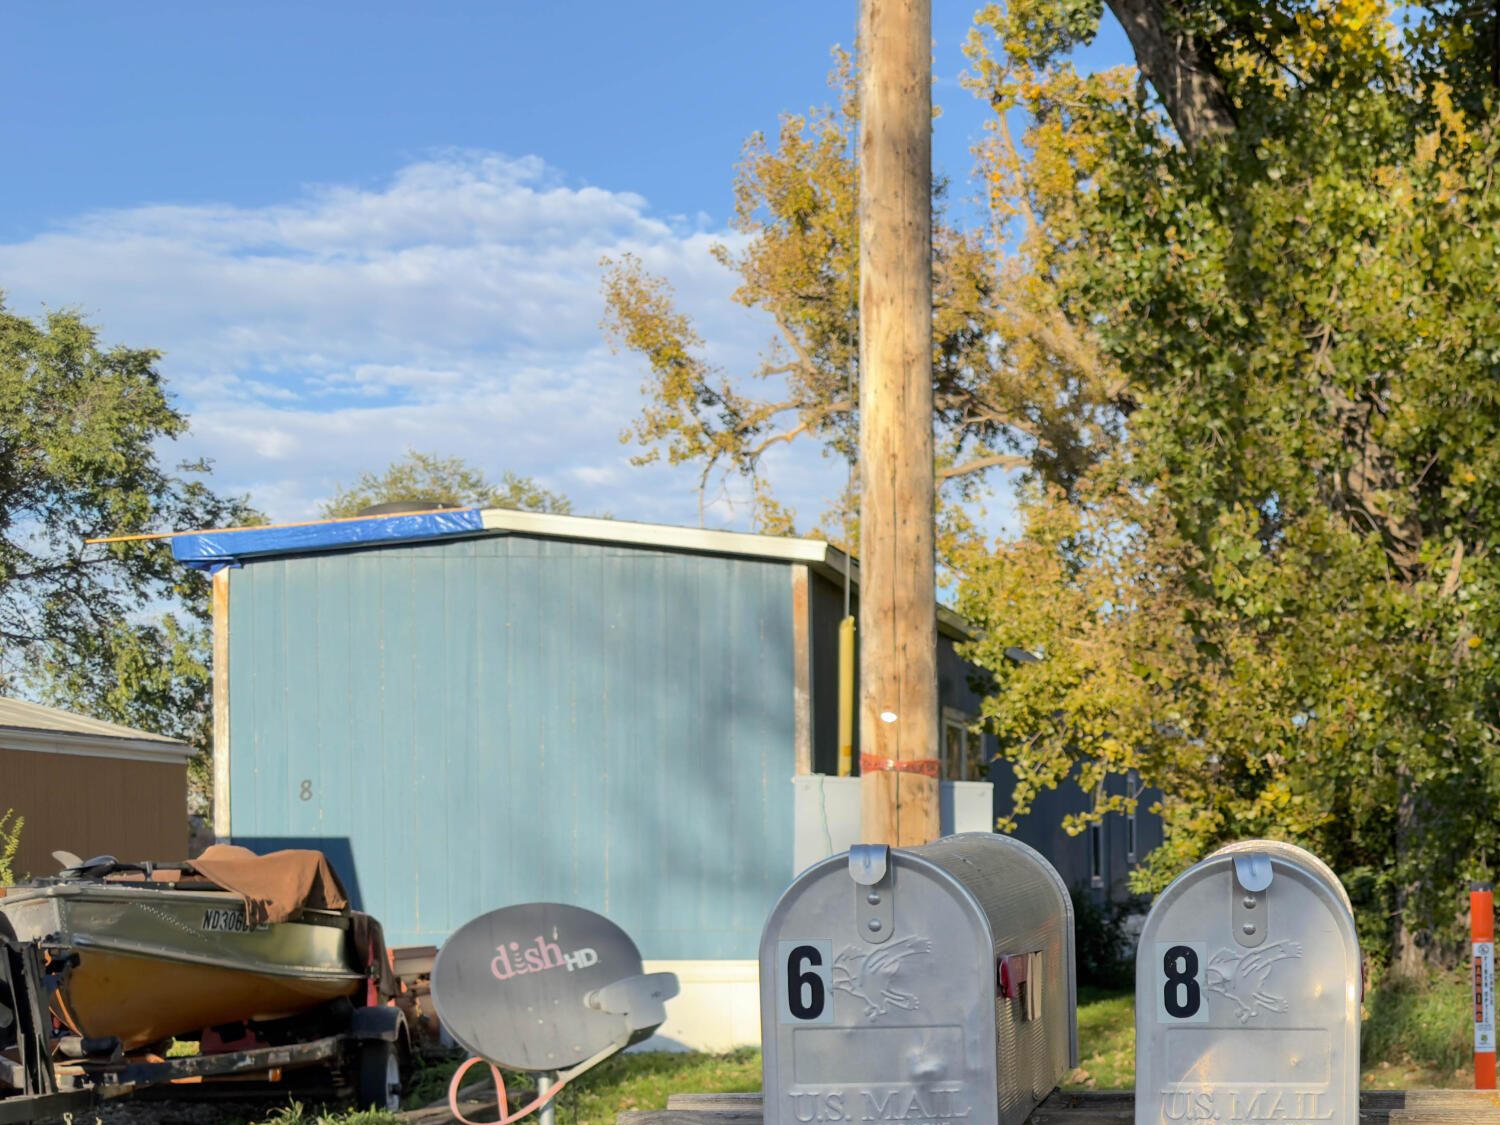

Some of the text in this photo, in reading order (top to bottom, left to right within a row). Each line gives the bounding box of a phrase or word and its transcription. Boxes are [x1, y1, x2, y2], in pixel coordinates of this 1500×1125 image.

[299, 779, 313, 802] 8
[491, 935, 599, 980] dish HD
[787, 945, 825, 1020] 6
[1163, 945, 1201, 1018] 8
[788, 1088, 973, 1122] U.S. MAIL
[1160, 1089, 1336, 1121] U.S. MAIL
